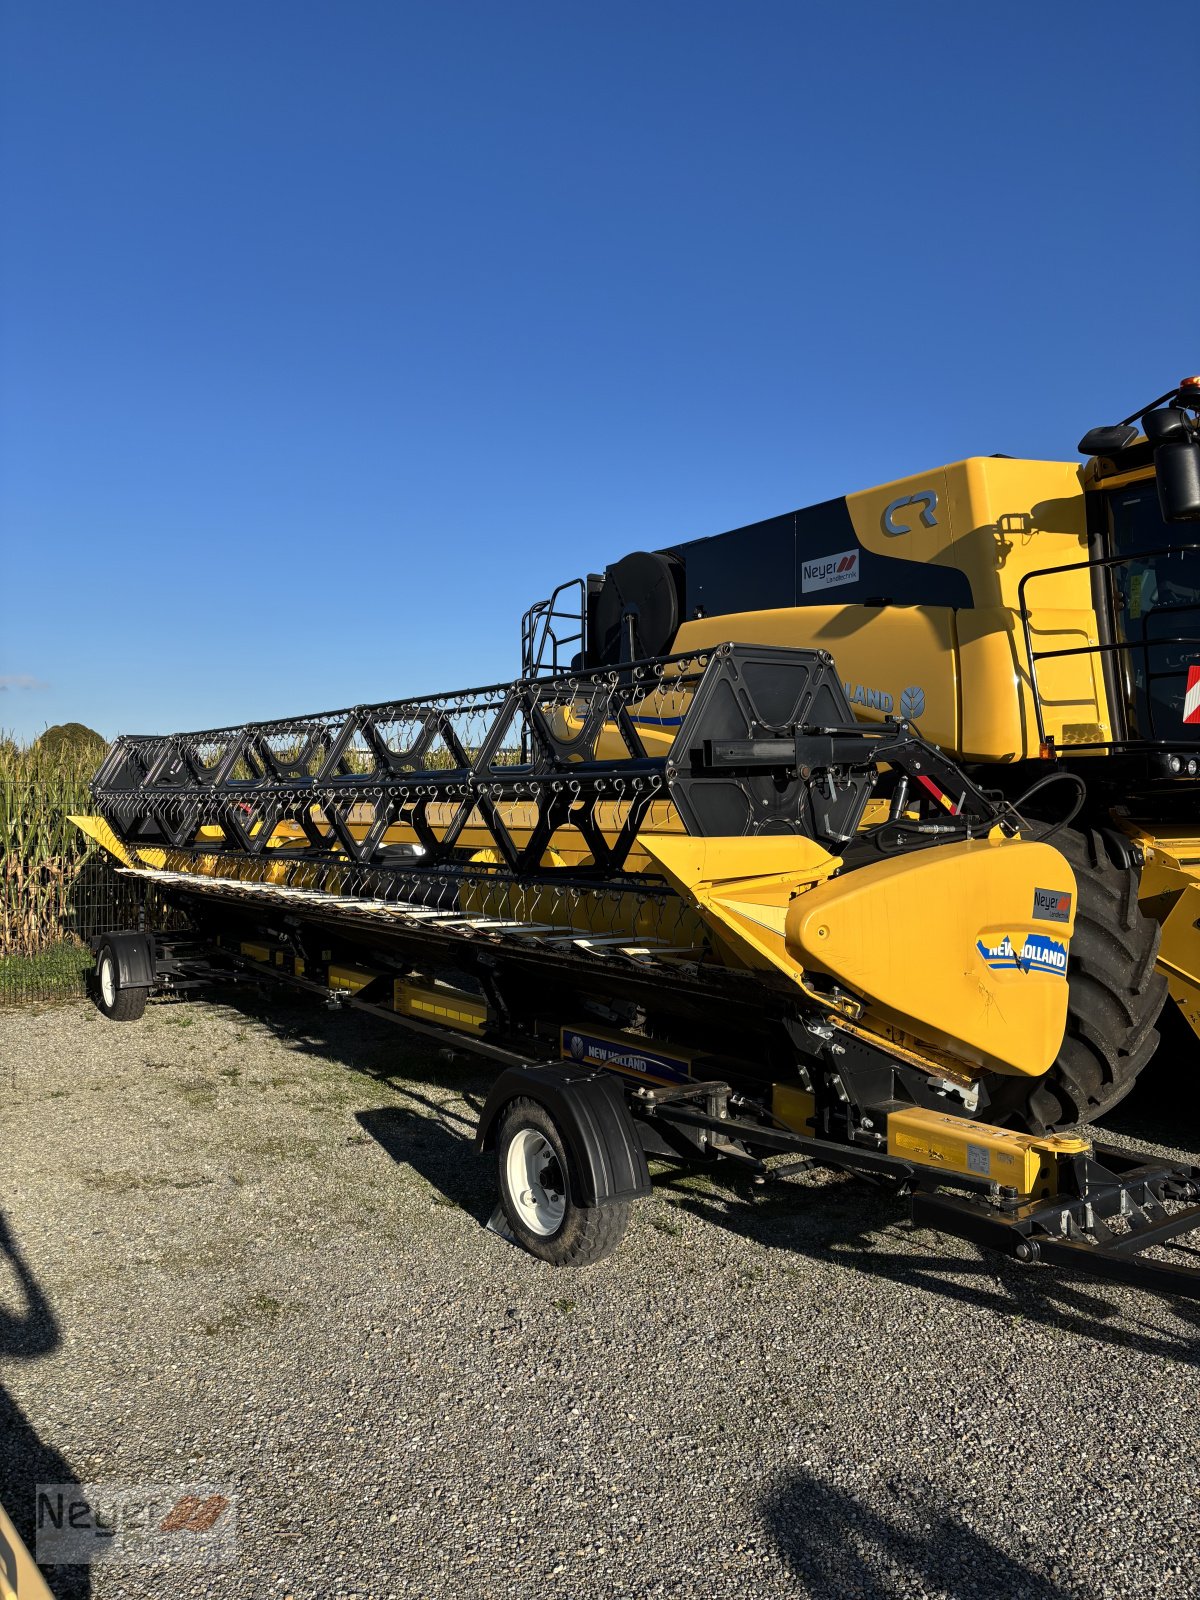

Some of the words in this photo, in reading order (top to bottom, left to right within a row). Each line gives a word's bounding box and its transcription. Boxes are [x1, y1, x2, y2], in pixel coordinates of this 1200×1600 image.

[885, 490, 938, 534] CR
[804, 562, 837, 580] Neyer
[844, 682, 894, 713] LAND
[1034, 891, 1058, 911] Neyer
[588, 1045, 607, 1061] NEW
